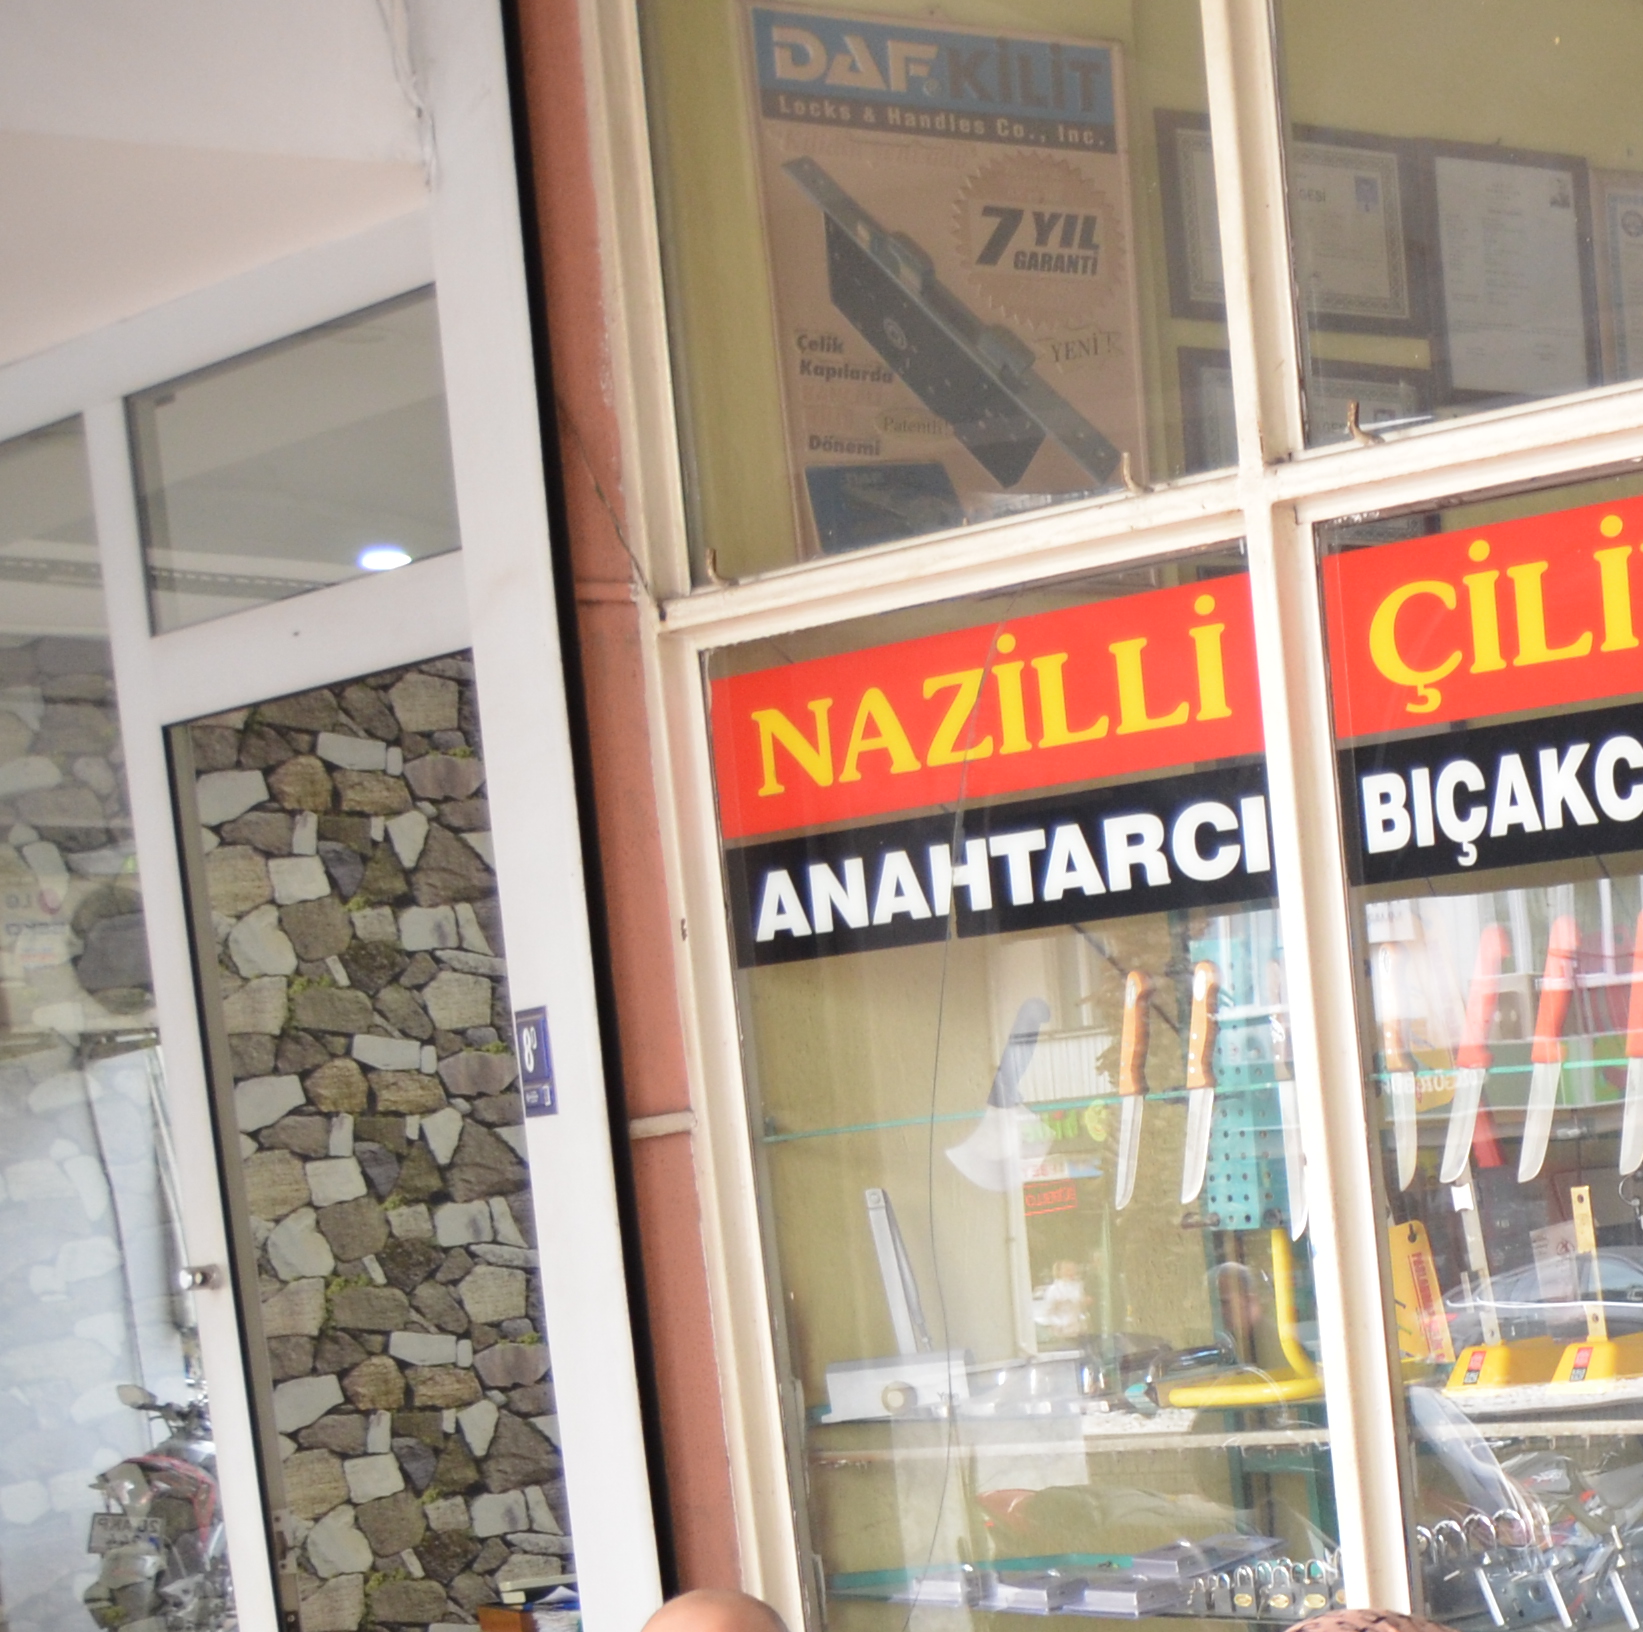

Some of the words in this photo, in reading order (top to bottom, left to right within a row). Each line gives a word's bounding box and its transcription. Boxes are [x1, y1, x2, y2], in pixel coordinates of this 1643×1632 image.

[771, 25, 939, 93] DAF
[946, 35, 1104, 113] KİLİT
[778, 93, 851, 121] Locks
[863, 108, 876, 125] &
[888, 108, 985, 136] Handles
[975, 204, 1025, 267] 7
[1031, 210, 1101, 250] YIL
[1012, 249, 1100, 277] GARANTİ
[797, 333, 844, 354] Çelik
[1051, 332, 1099, 363] YENİ
[799, 358, 895, 384] Kapılarda
[808, 433, 882, 456] Dönemi
[751, 594, 1232, 797] NAZİLLİ
[755, 795, 1273, 943] ANAHTARCI
